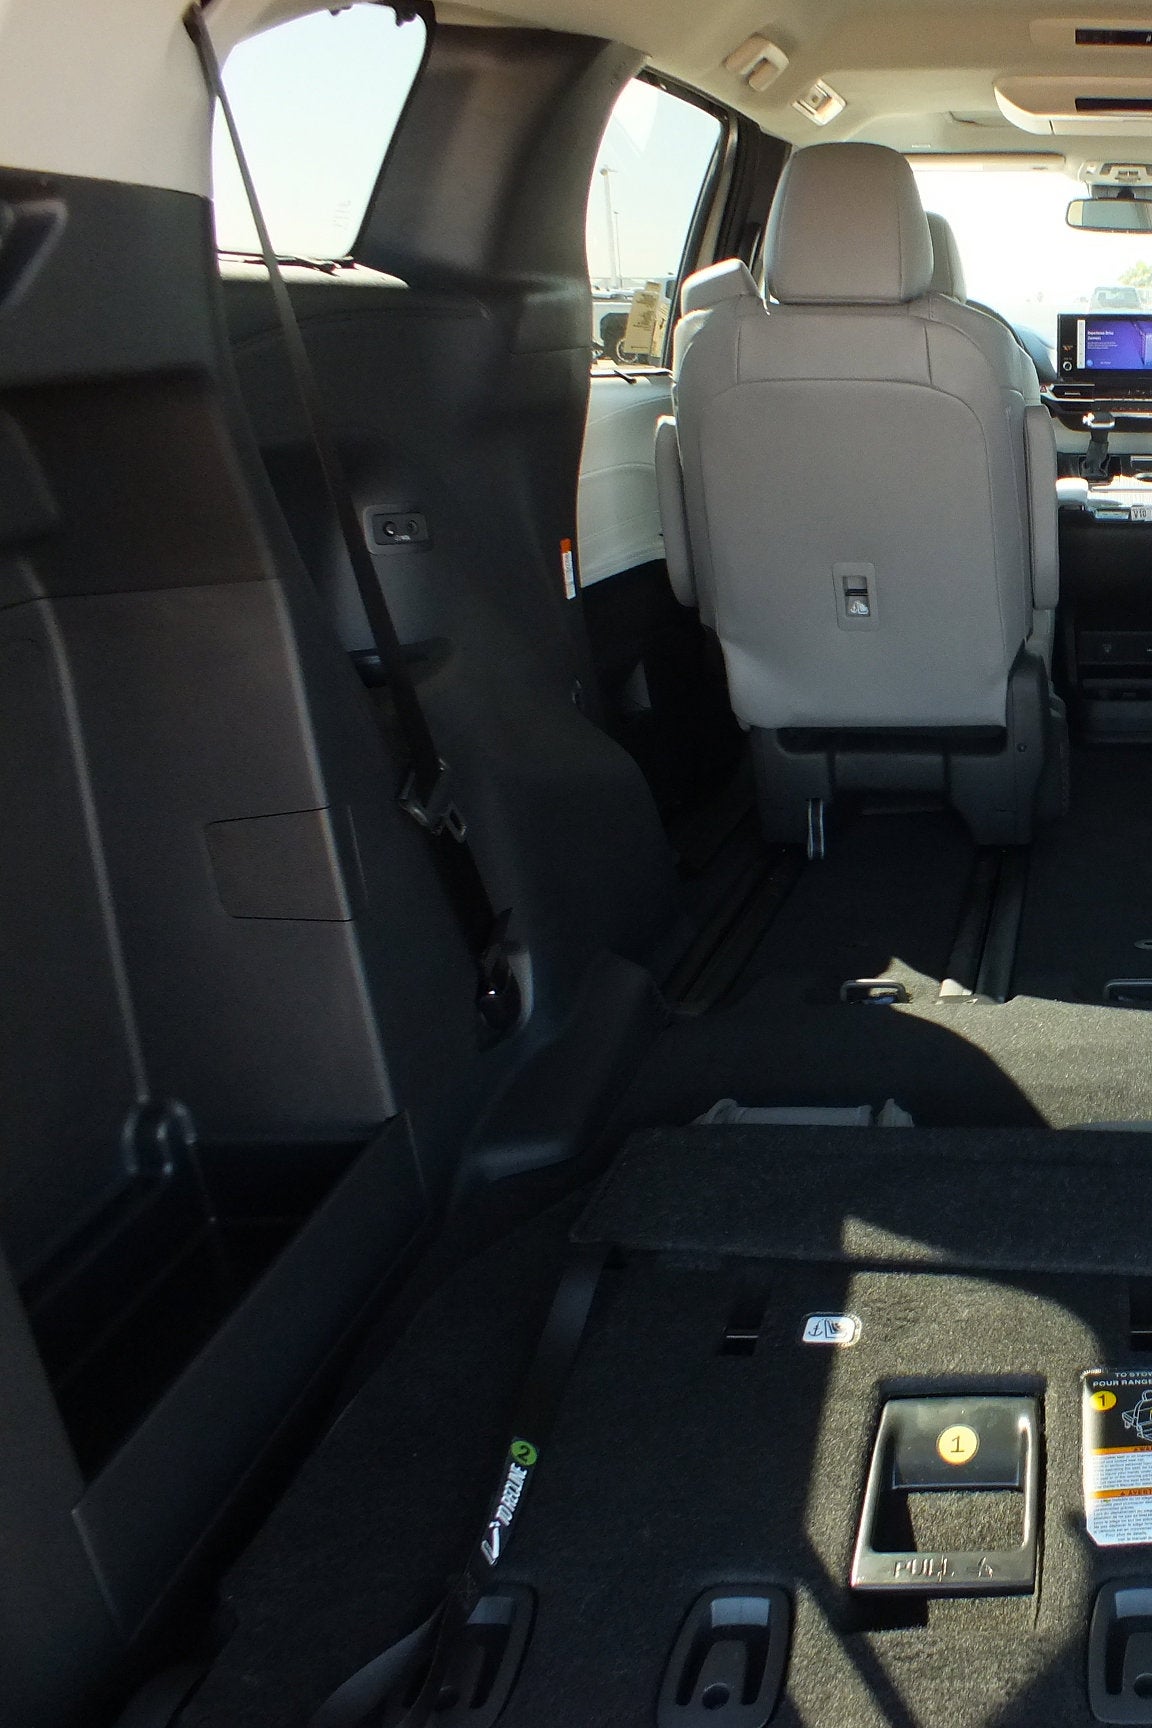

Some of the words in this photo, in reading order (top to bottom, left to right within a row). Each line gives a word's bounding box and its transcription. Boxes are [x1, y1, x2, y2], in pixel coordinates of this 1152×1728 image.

[1092, 1379, 1119, 1387] POUR
[1098, 1393, 1106, 1407] 1
[949, 1435, 965, 1453] 1
[517, 1445, 531, 1464] 2
[500, 1462, 528, 1513] RECLINE
[893, 1557, 949, 1578] PULL
